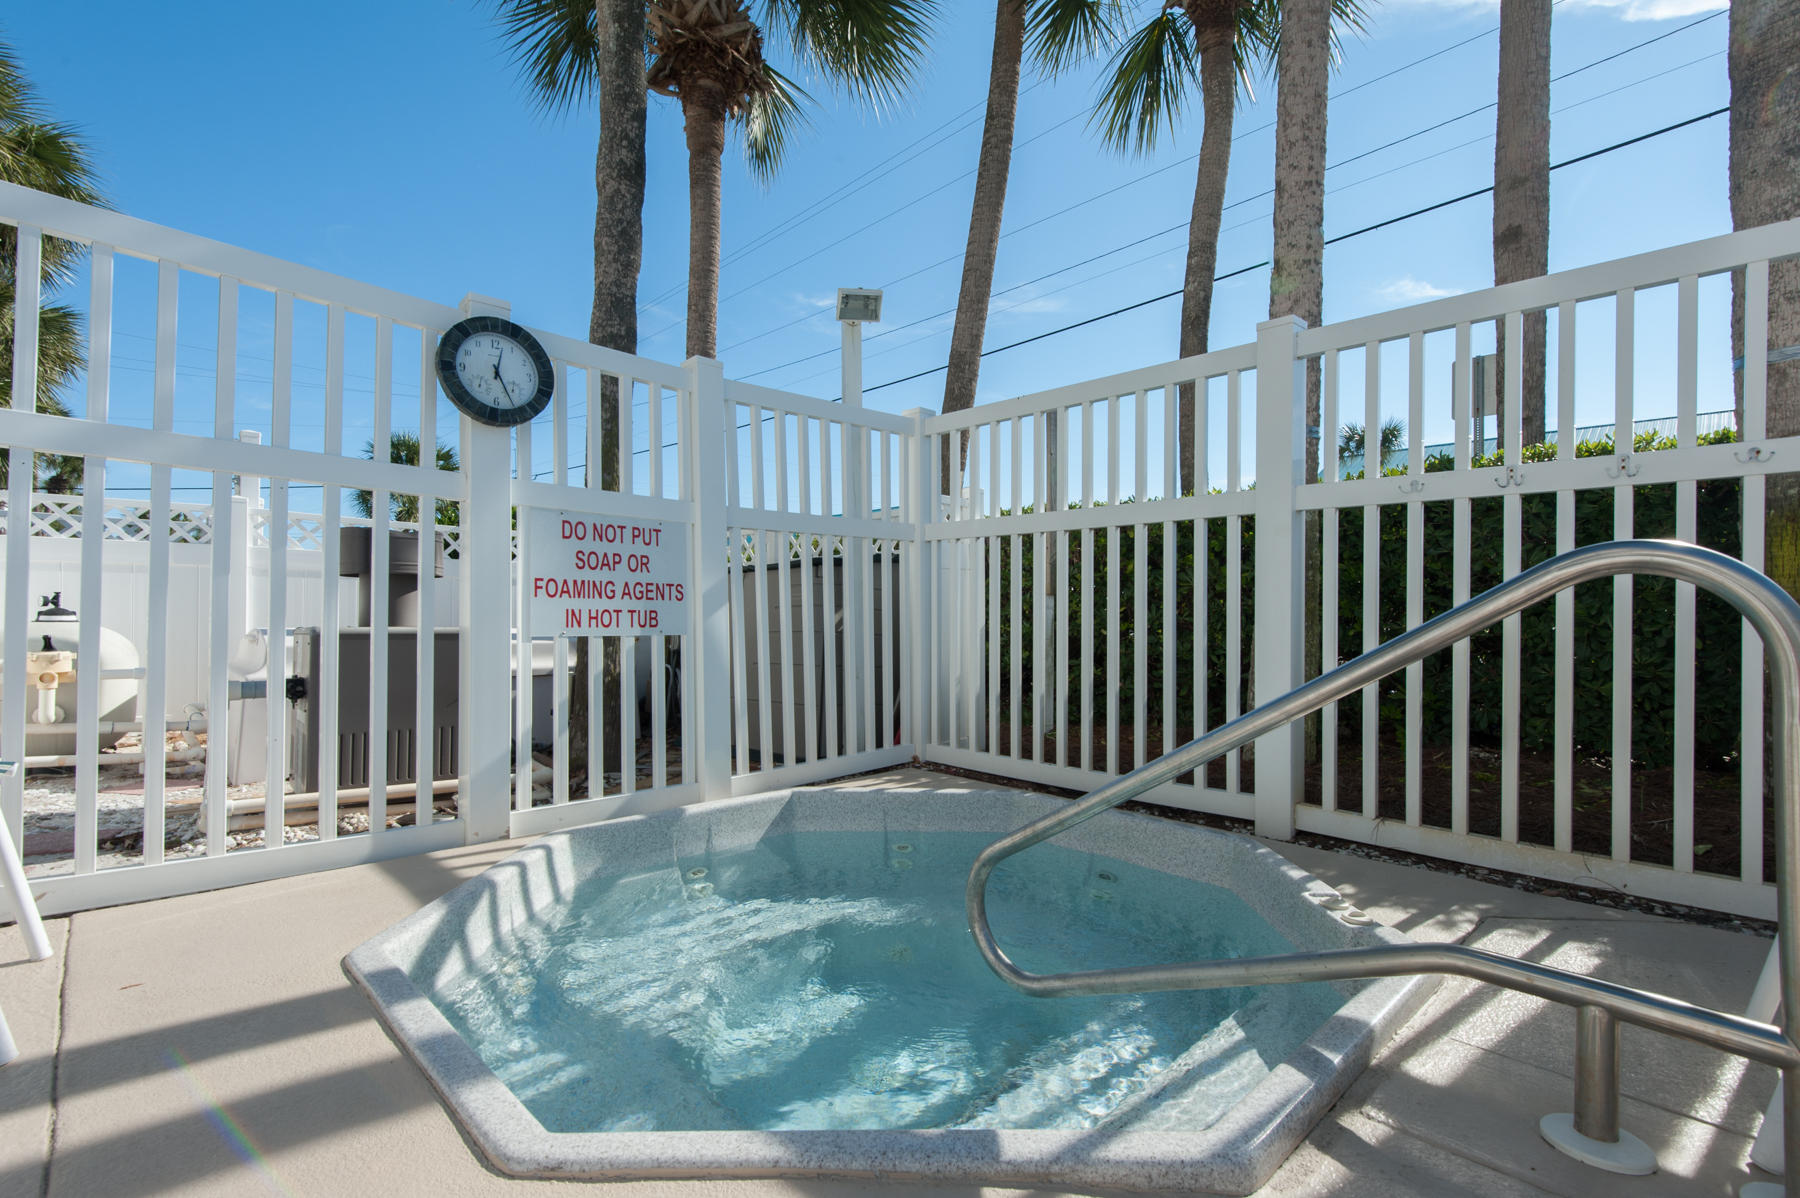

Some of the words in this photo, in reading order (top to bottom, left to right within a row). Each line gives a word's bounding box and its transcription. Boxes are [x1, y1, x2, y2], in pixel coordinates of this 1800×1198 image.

[493, 397, 500, 407] 6
[562, 519, 587, 541] DO
[592, 523, 627, 545] NOT
[631, 526, 662, 547] PUT
[575, 550, 622, 572] SOAP
[627, 554, 651, 574] OR
[533, 577, 616, 601] FOAMING
[621, 581, 684, 602] AGENTS
[565, 608, 582, 629] IN
[588, 608, 623, 629] HOT
[628, 609, 659, 629] TUB
